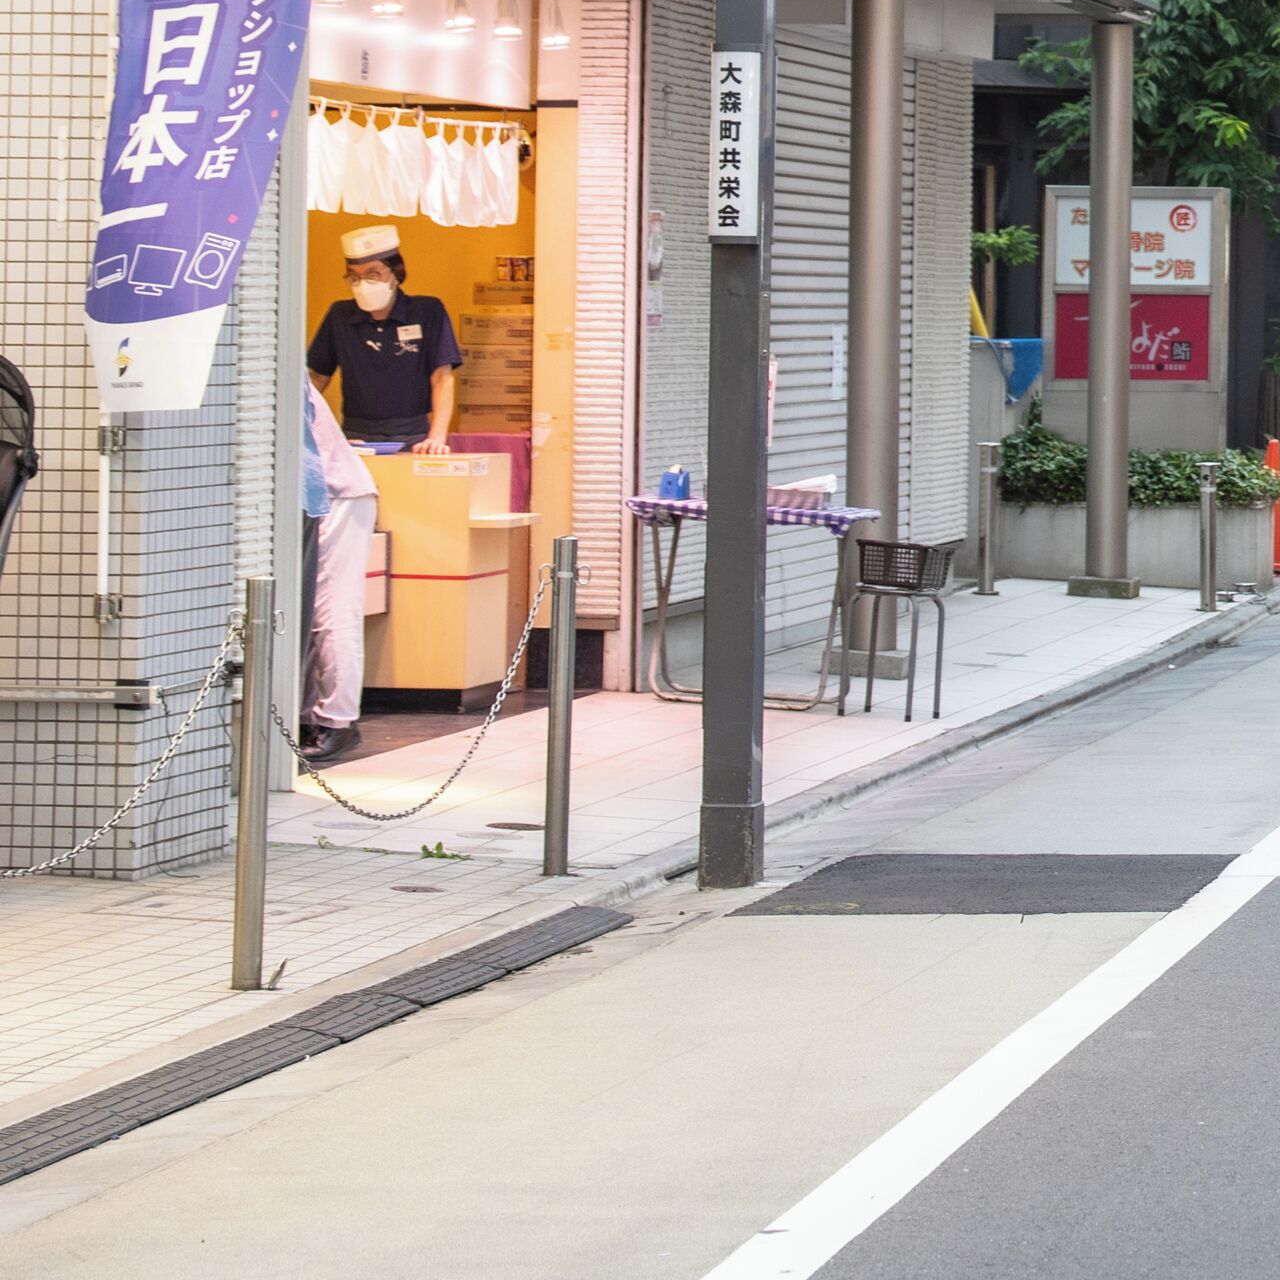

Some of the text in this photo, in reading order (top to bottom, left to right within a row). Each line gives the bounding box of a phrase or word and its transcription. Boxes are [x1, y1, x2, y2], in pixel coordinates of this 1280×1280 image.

[718, 61, 742, 229] 大森町共栄会
